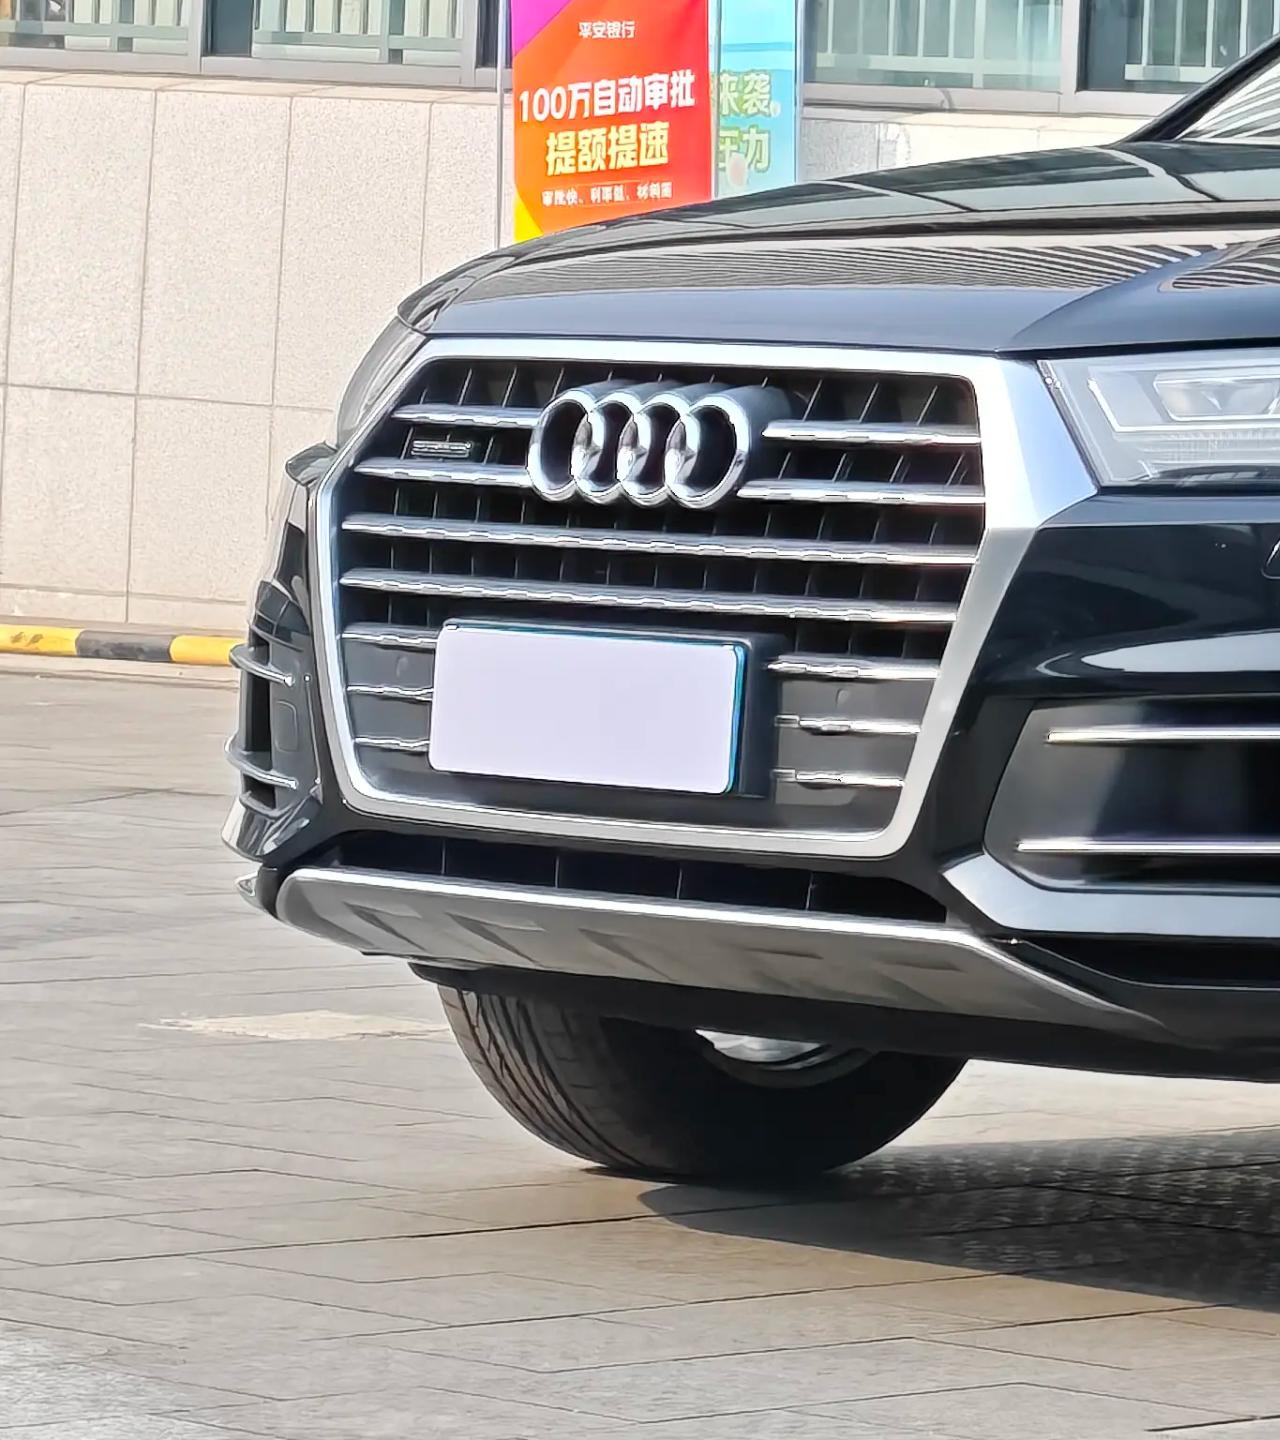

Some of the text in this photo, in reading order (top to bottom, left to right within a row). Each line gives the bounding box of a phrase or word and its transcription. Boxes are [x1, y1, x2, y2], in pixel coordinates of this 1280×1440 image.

[579, 21, 636, 39] 平安银行
[519, 69, 696, 123] 100万自动审批
[546, 121, 670, 176] 提额提速
